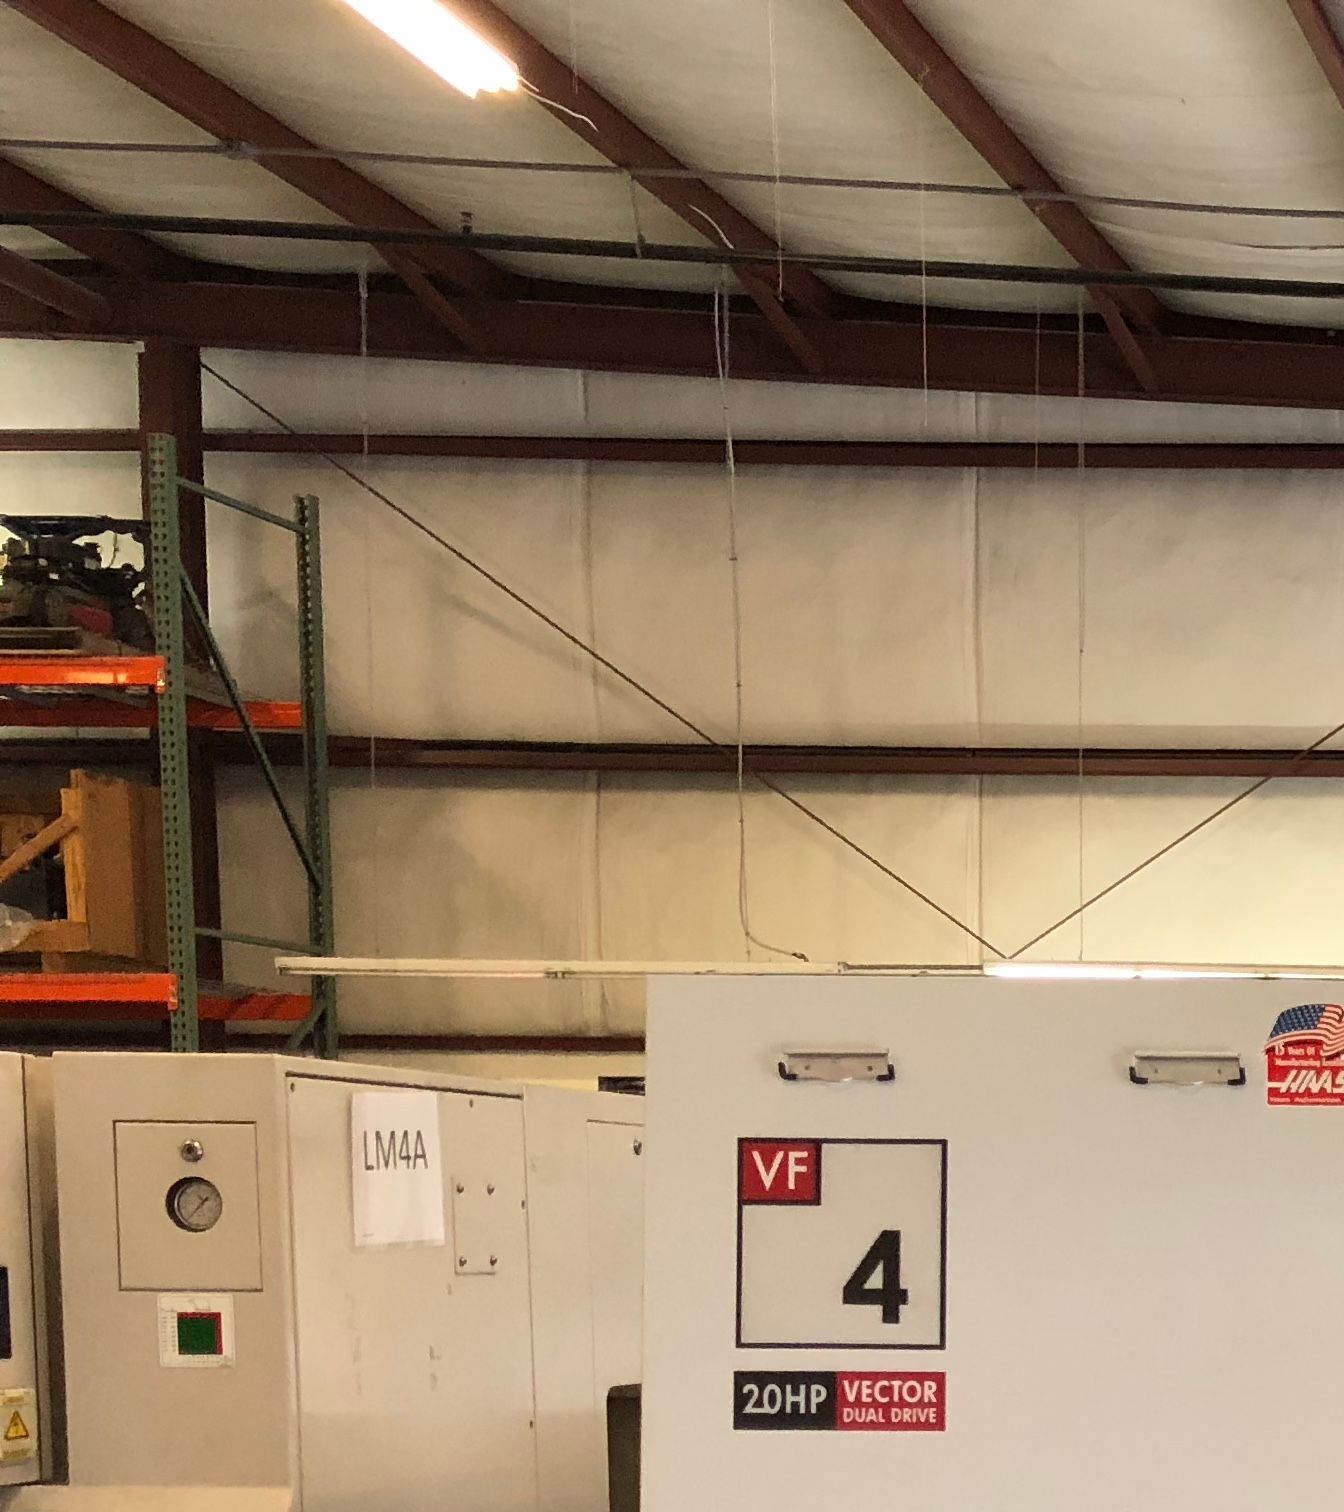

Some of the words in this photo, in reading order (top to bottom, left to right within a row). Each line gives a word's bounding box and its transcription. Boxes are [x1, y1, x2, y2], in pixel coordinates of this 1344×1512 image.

[362, 1130, 428, 1171] LM4A
[751, 1150, 809, 1191] VF
[842, 1229, 909, 1324] 4
[742, 1384, 828, 1414] 20HP
[843, 1379, 937, 1404] VECTOR
[843, 1407, 885, 1423] DUAL
[891, 1407, 937, 1423] DRIVE
